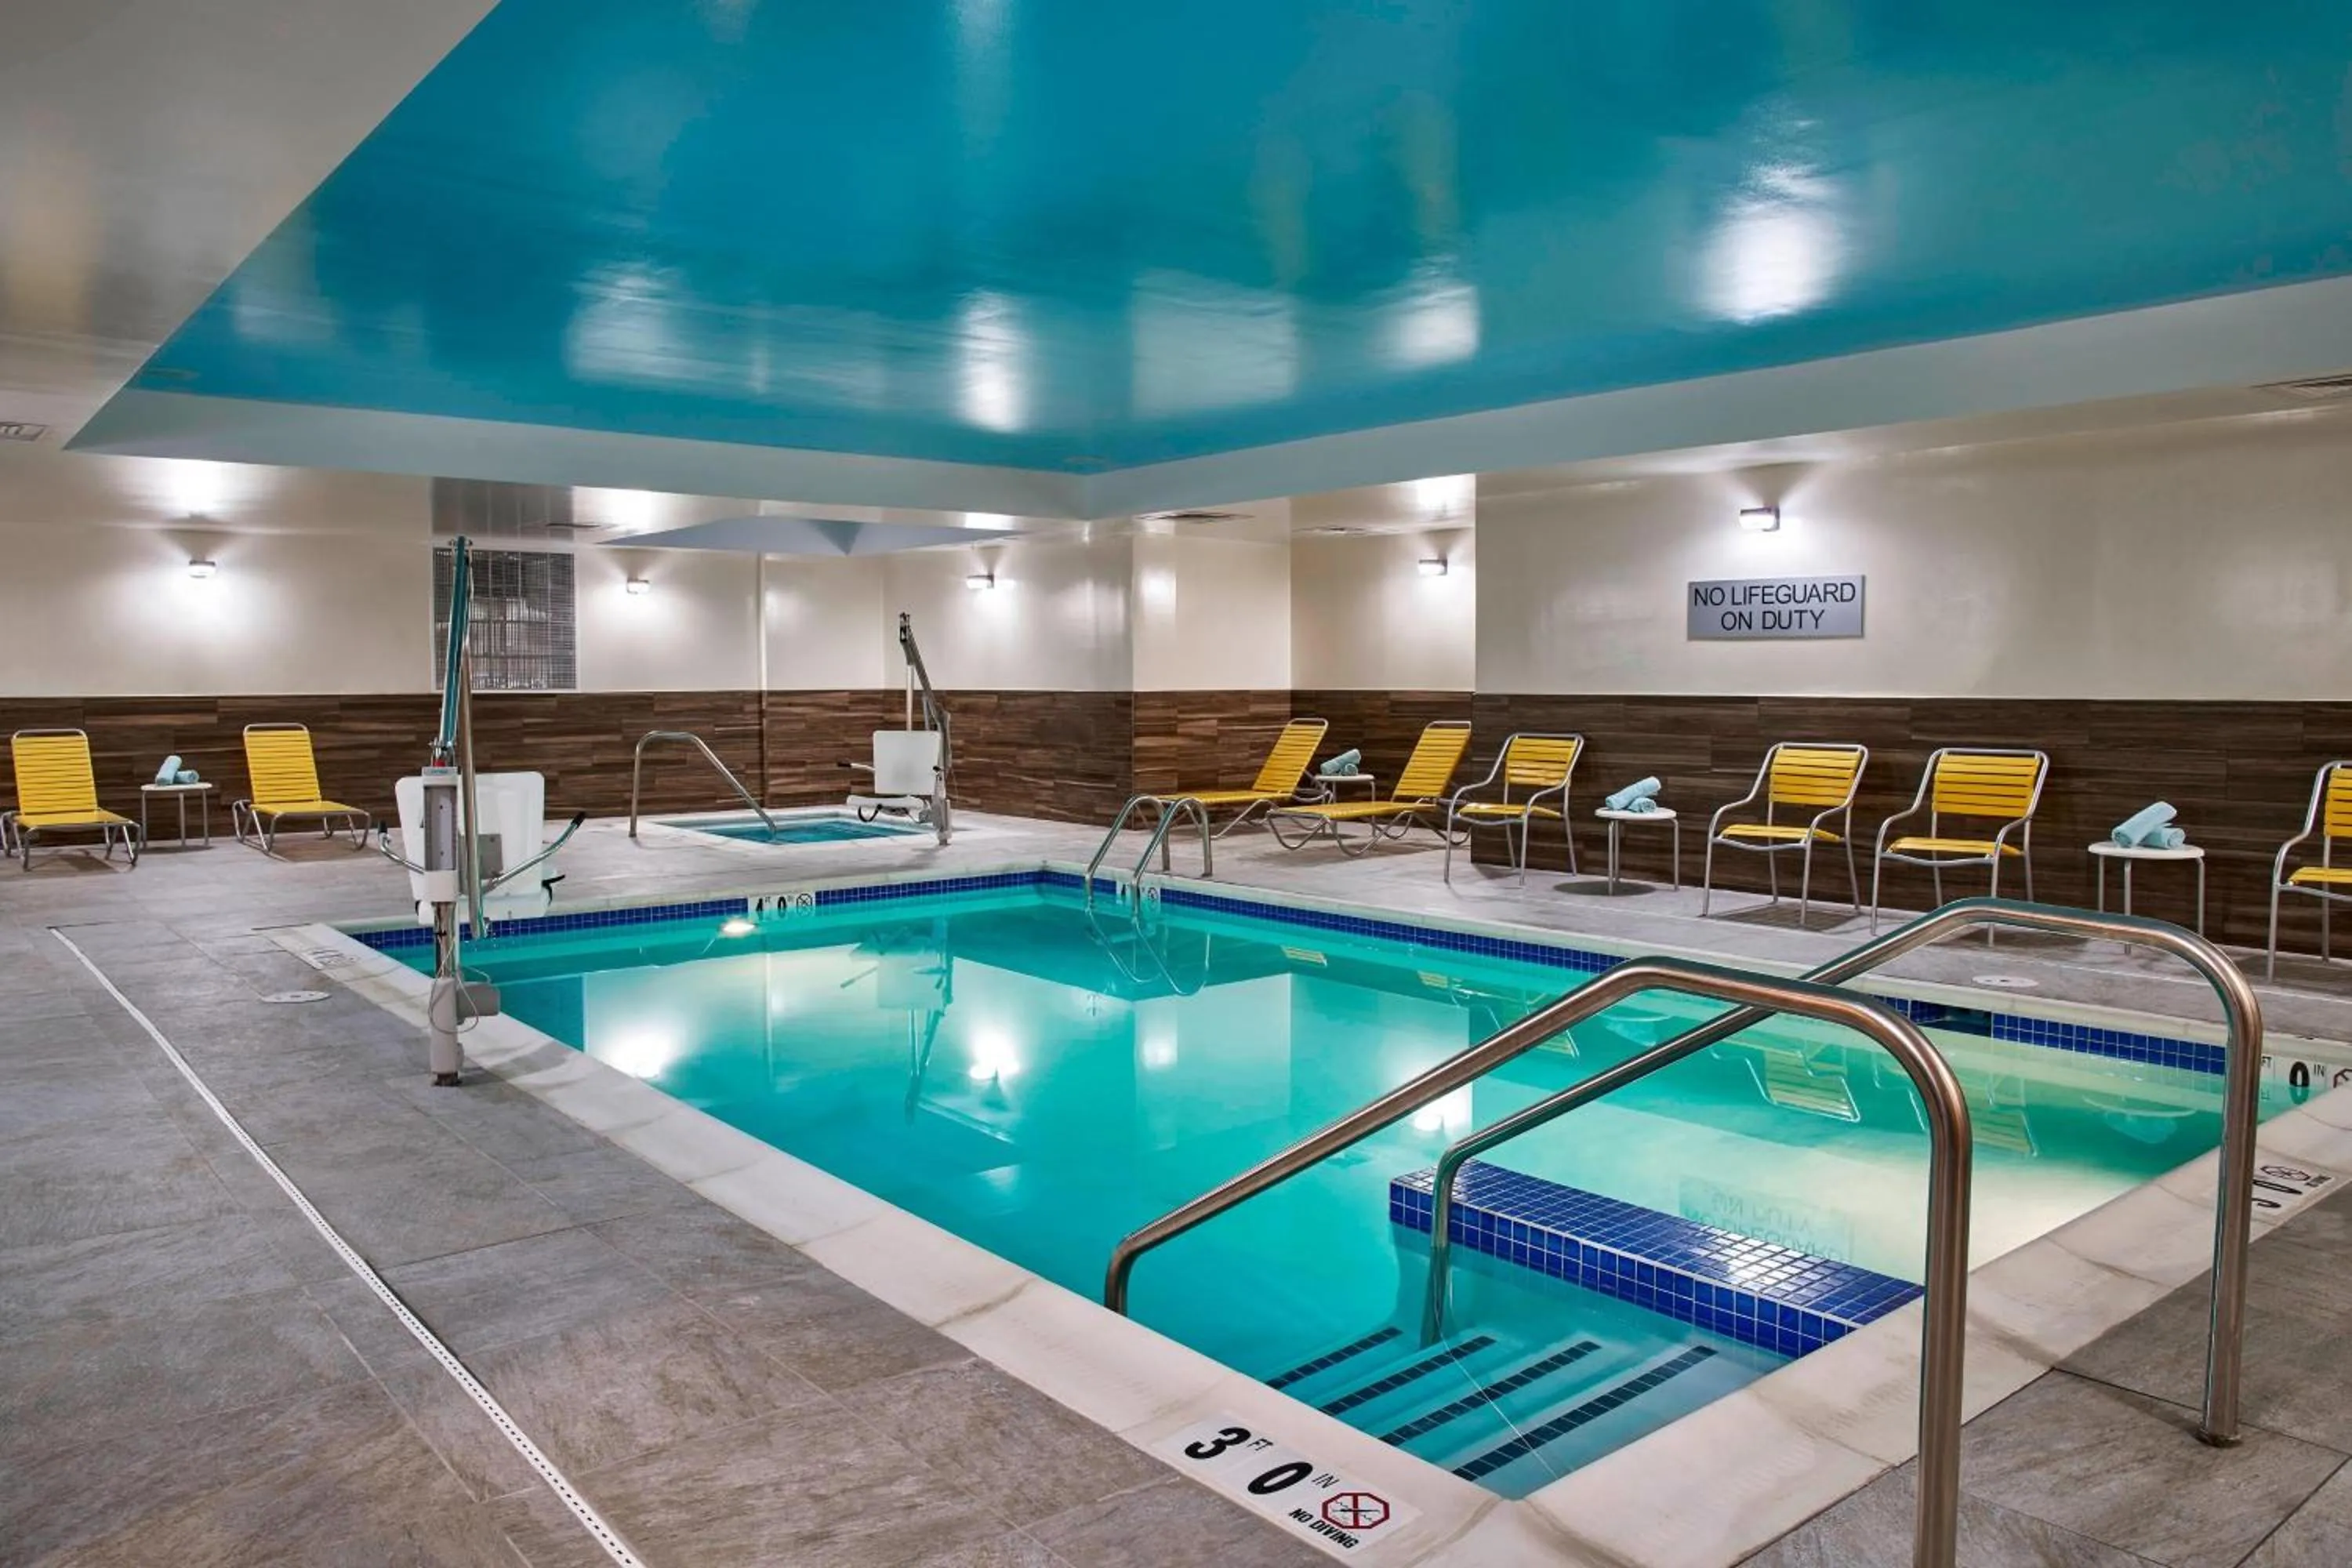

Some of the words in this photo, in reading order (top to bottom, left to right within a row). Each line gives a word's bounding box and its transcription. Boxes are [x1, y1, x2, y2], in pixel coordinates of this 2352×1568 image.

[1694, 586, 1725, 607] NO
[1731, 583, 1856, 606] LIFEGUARD
[1721, 611, 1753, 631] ON
[1762, 609, 1824, 630] DUTY
[2314, 1064, 2326, 1078] IN
[1185, 1427, 1251, 1460] 3
[1247, 1438, 1274, 1451] FT
[1247, 1461, 1313, 1495] 0
[1312, 1473, 1340, 1489] IN
[1288, 1508, 1314, 1523] NO
[1308, 1519, 1359, 1548] DIVING
